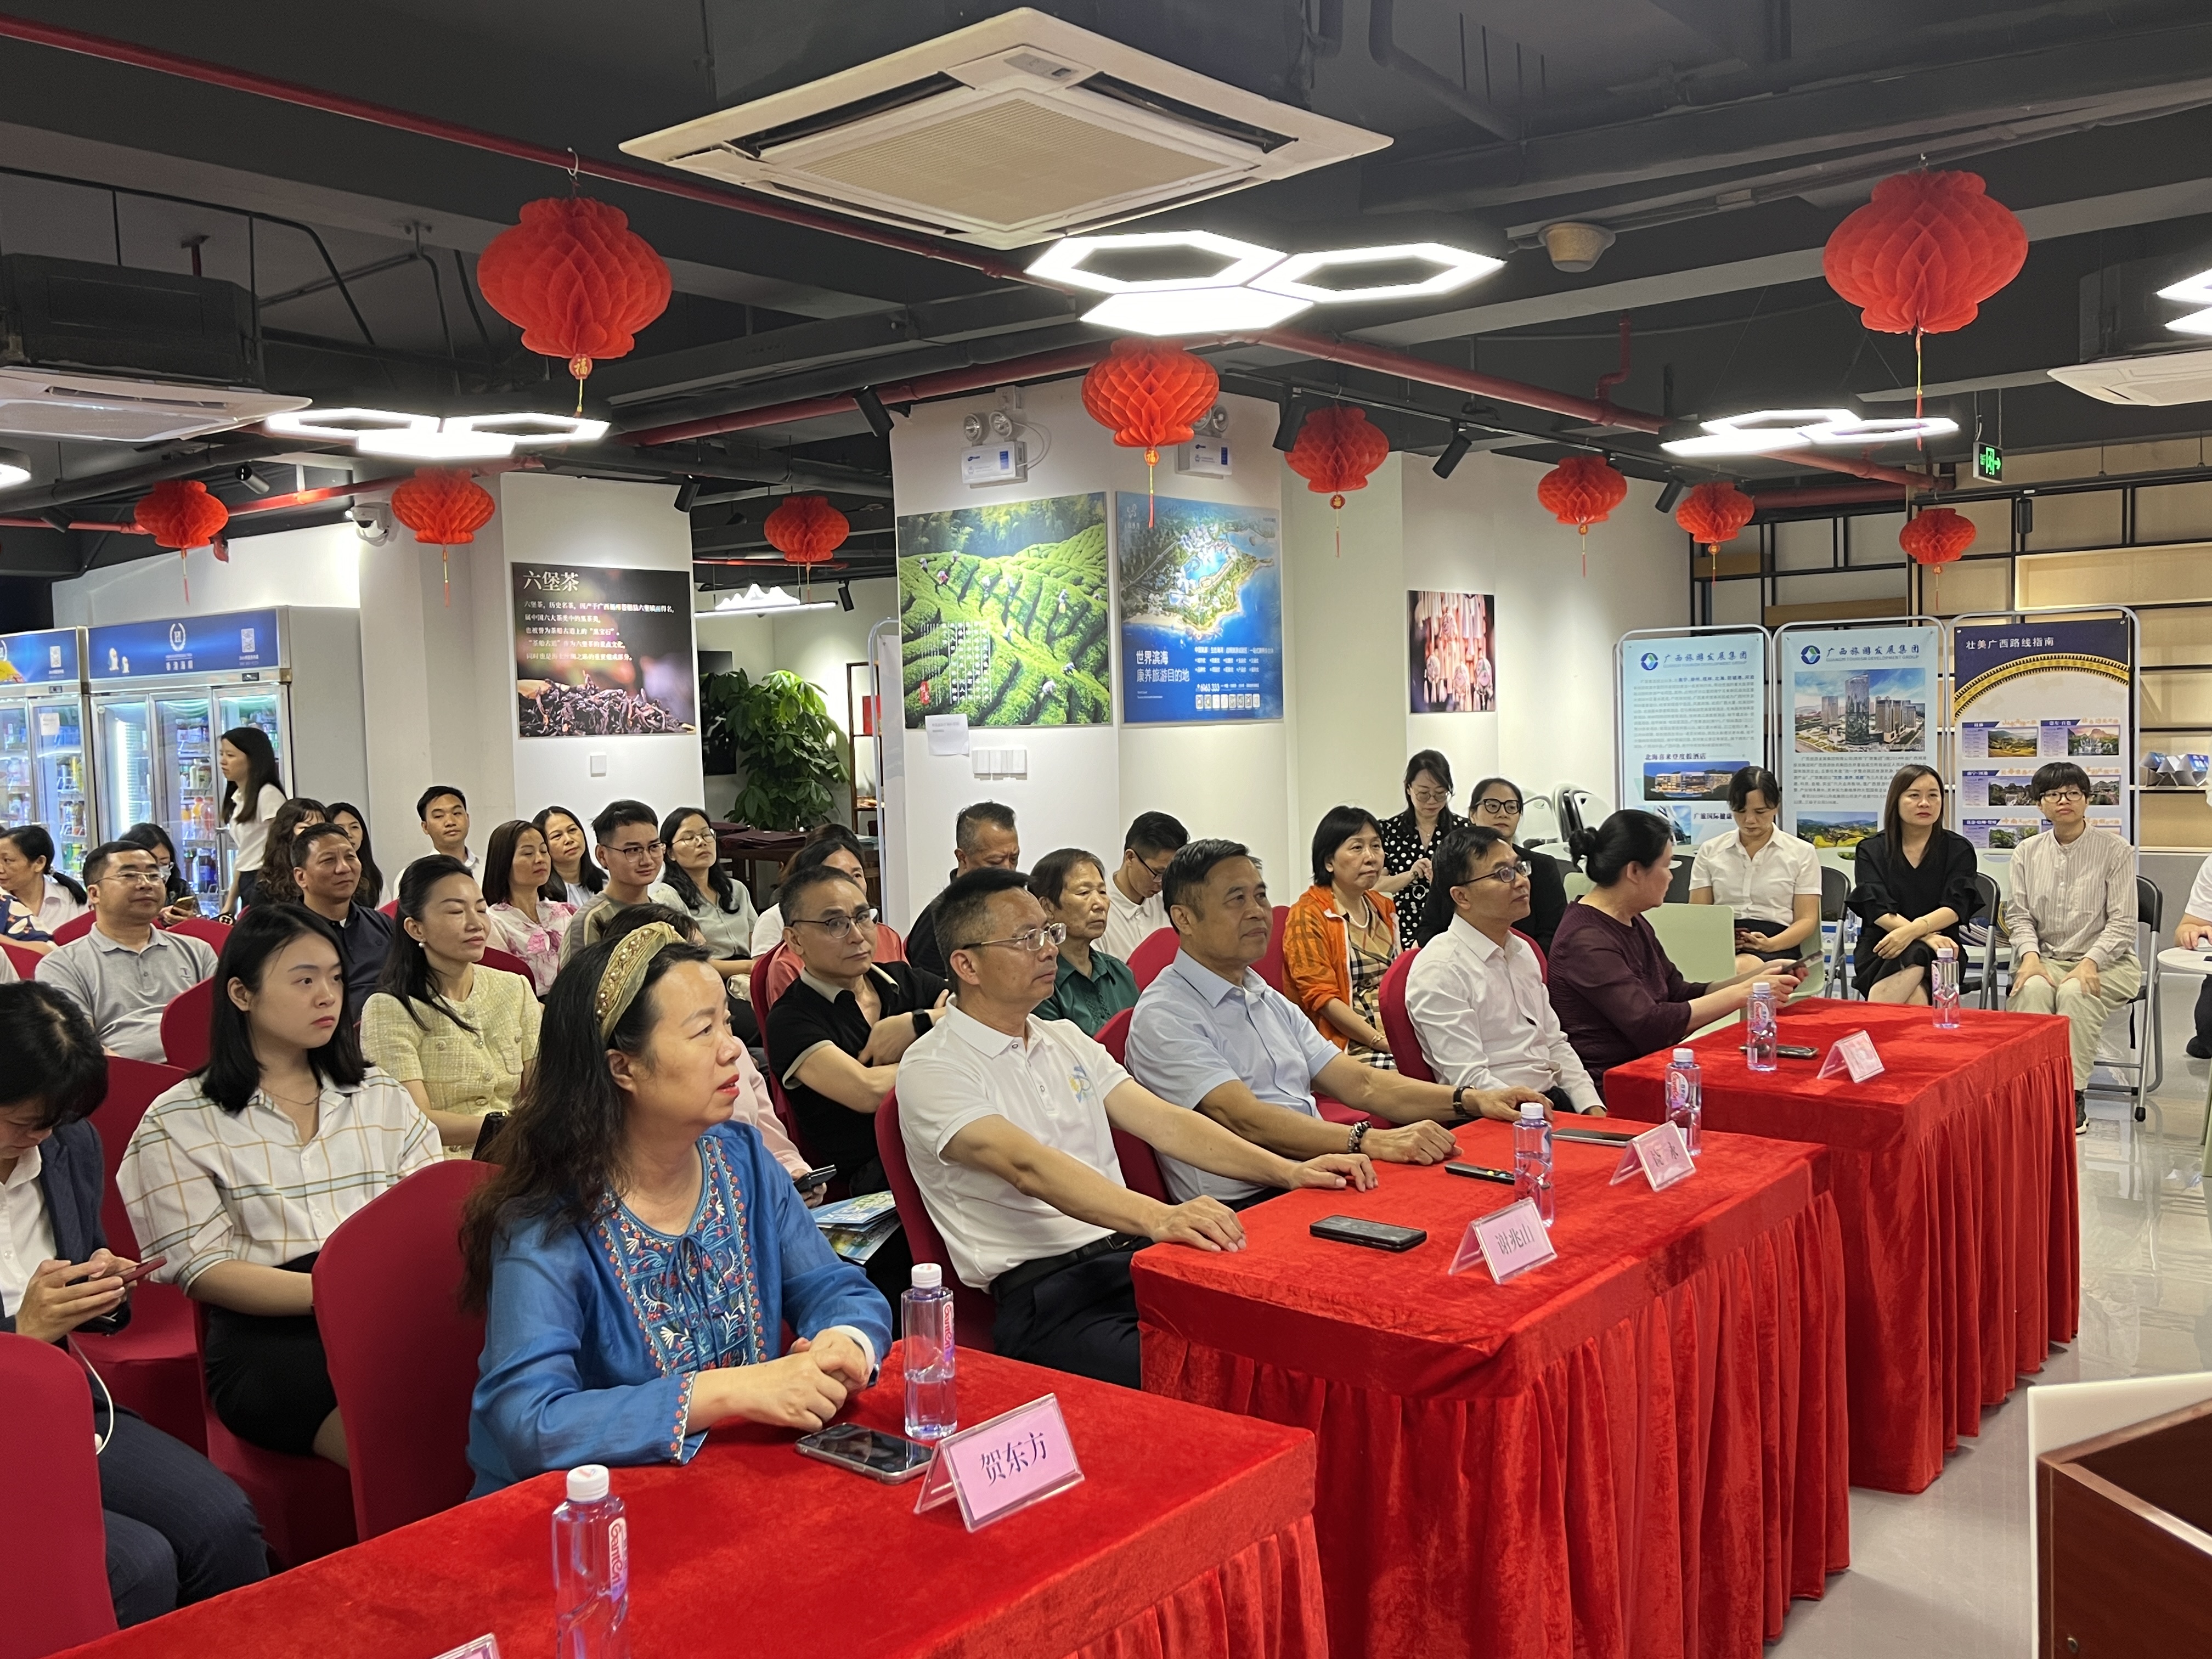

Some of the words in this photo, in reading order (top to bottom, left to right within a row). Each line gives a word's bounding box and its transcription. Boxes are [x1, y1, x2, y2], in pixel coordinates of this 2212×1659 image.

[574, 358, 588, 375] 福
[523, 571, 579, 592] 六堡茶
[1826, 644, 1920, 657] 广西旅游发展集团
[1966, 636, 2054, 650] 壮美广西路线指南
[1136, 650, 1168, 665] 世界滨海
[1663, 651, 1747, 663] 广西旅游发展集团
[1137, 668, 1190, 682] 康养旅游目的地
[1494, 1223, 1535, 1255] 谢兆山
[979, 1431, 1046, 1487] 贺东方
[611, 1523, 623, 1585] Ganten
